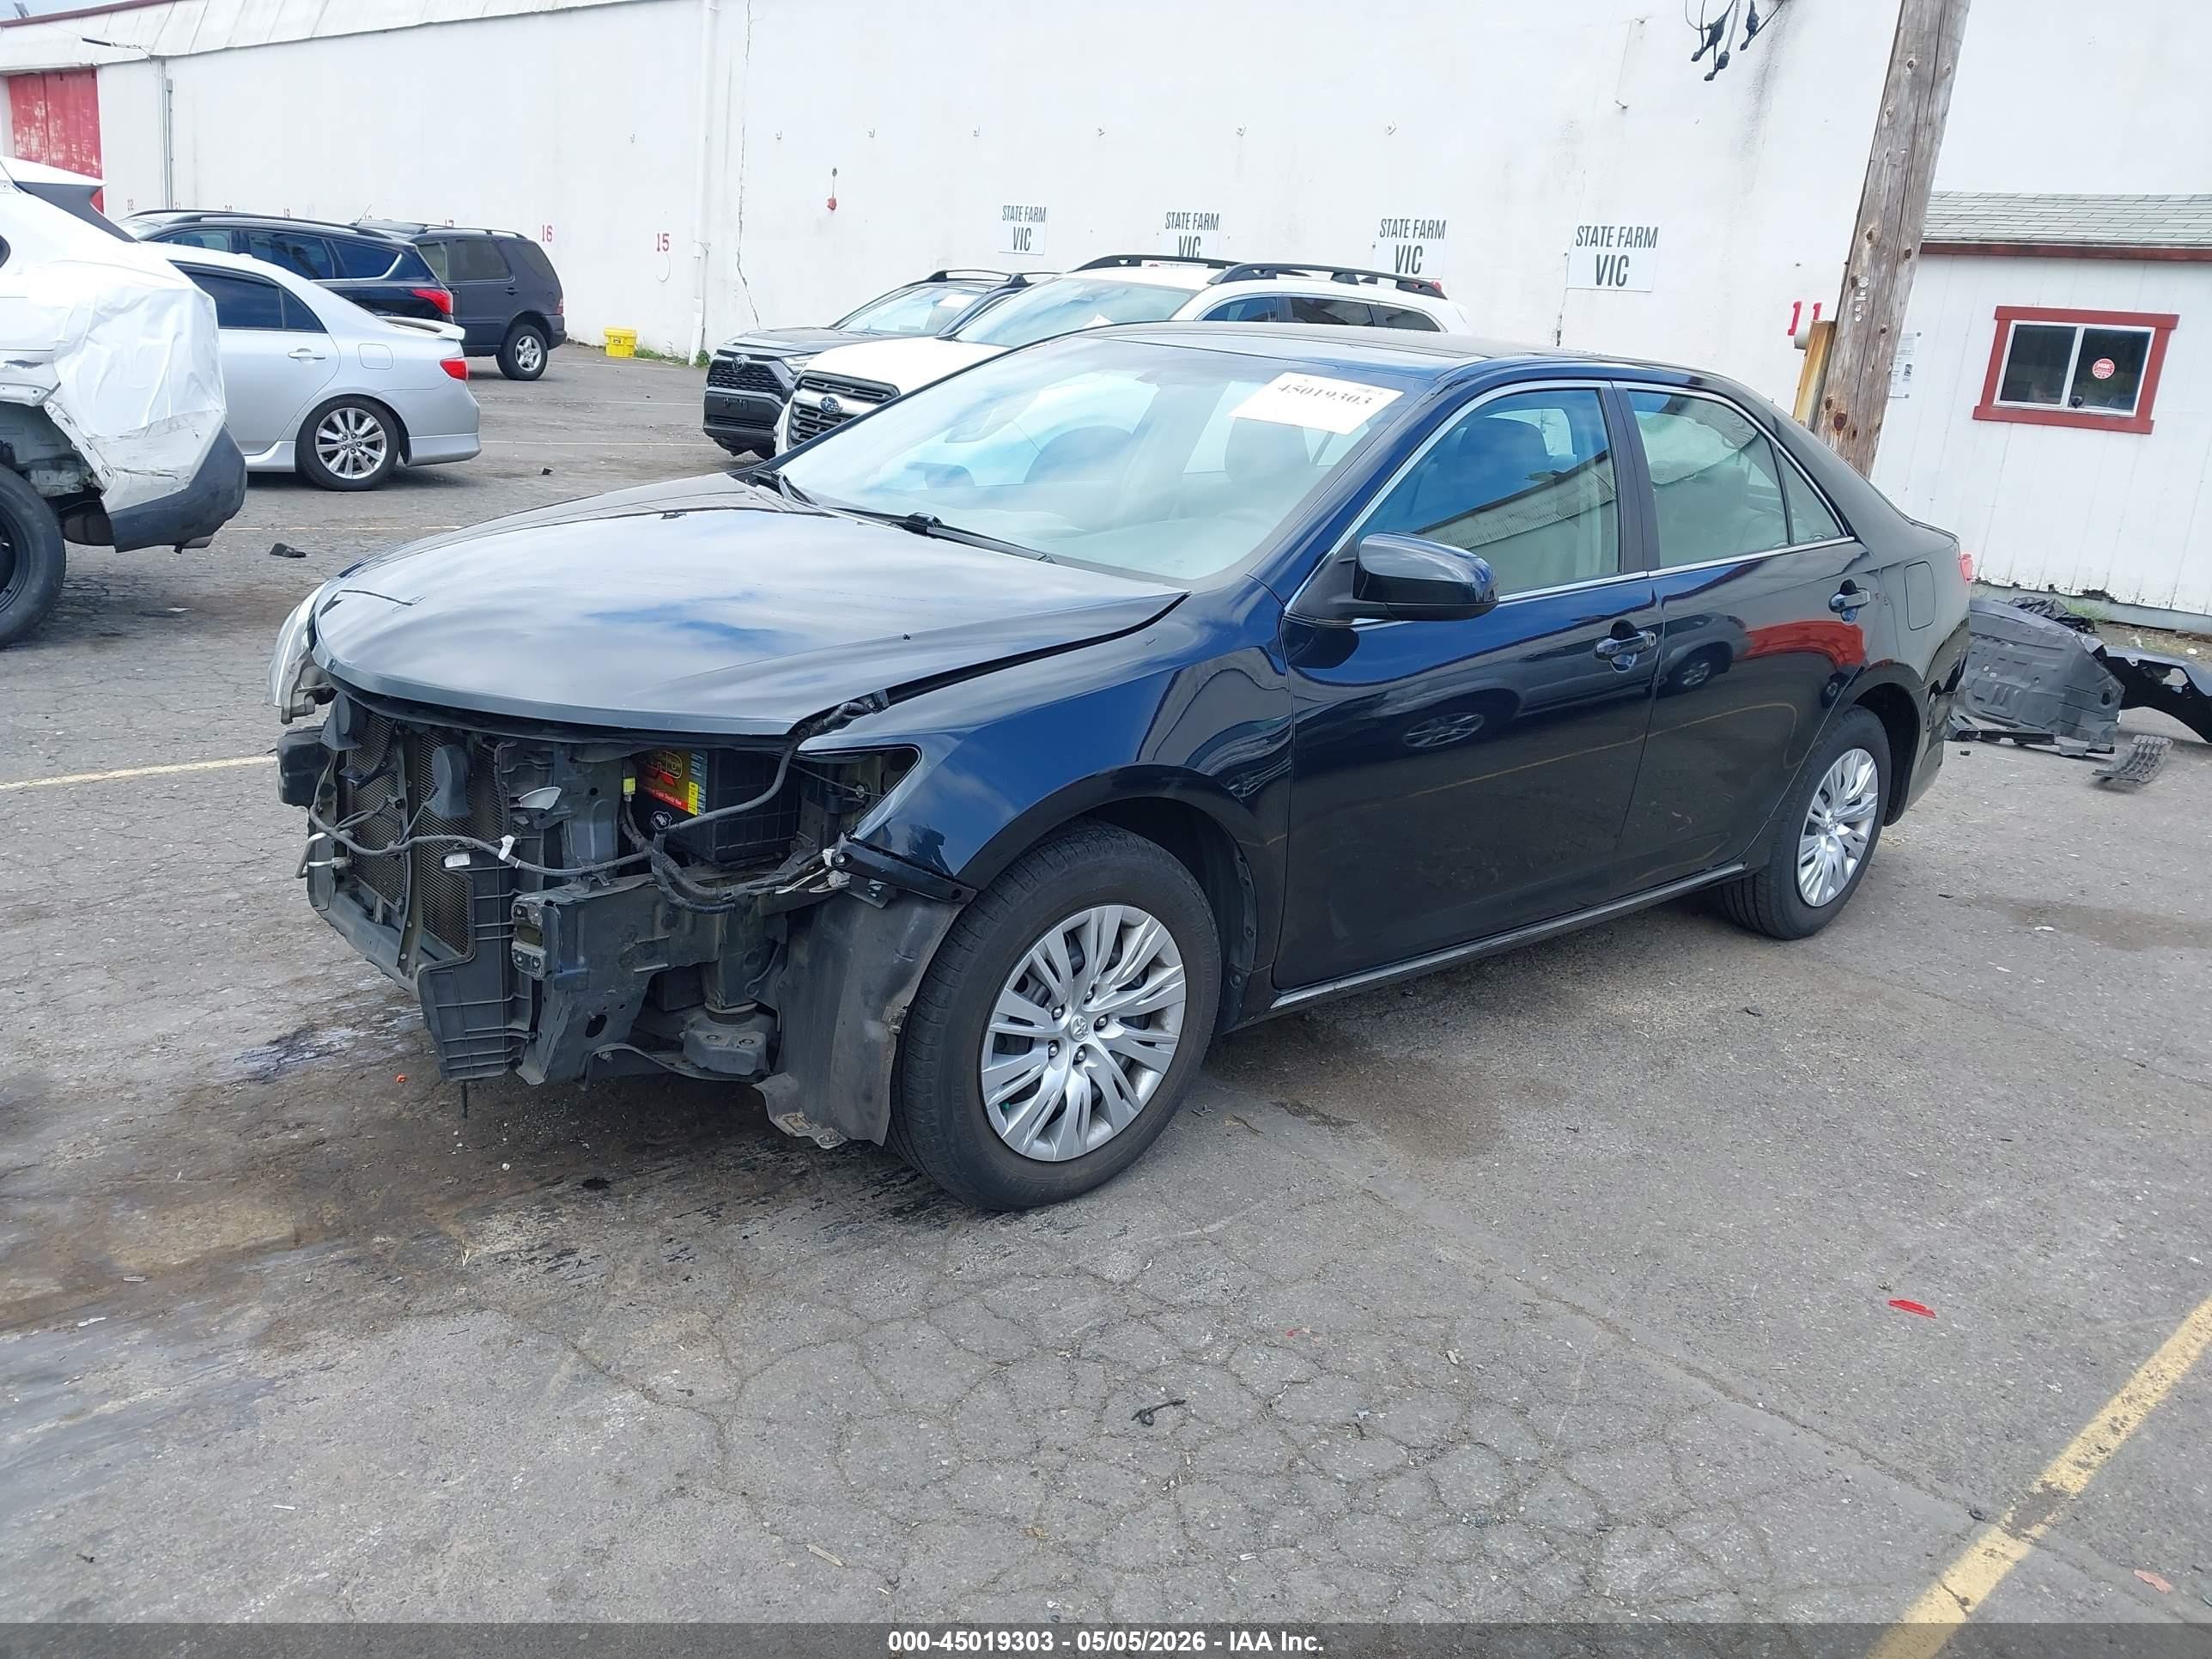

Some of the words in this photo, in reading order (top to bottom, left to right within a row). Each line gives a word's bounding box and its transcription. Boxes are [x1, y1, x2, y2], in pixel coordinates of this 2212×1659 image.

[1002, 205, 1024, 222] STATE
[1024, 206, 1047, 222] FARM
[1165, 212, 1191, 229] STATE
[1193, 213, 1219, 231] FARM
[542, 224, 553, 242] 16
[1013, 226, 1031, 251] VIC
[1379, 218, 1411, 239] STATE
[1413, 219, 1447, 240] FARM
[1576, 225, 1614, 247] STATE
[1617, 226, 1659, 248] FARM
[656, 233, 670, 252] 15
[1178, 235, 1201, 258] VIC
[1395, 245, 1424, 275] VIC
[1595, 254, 1630, 287] VIC
